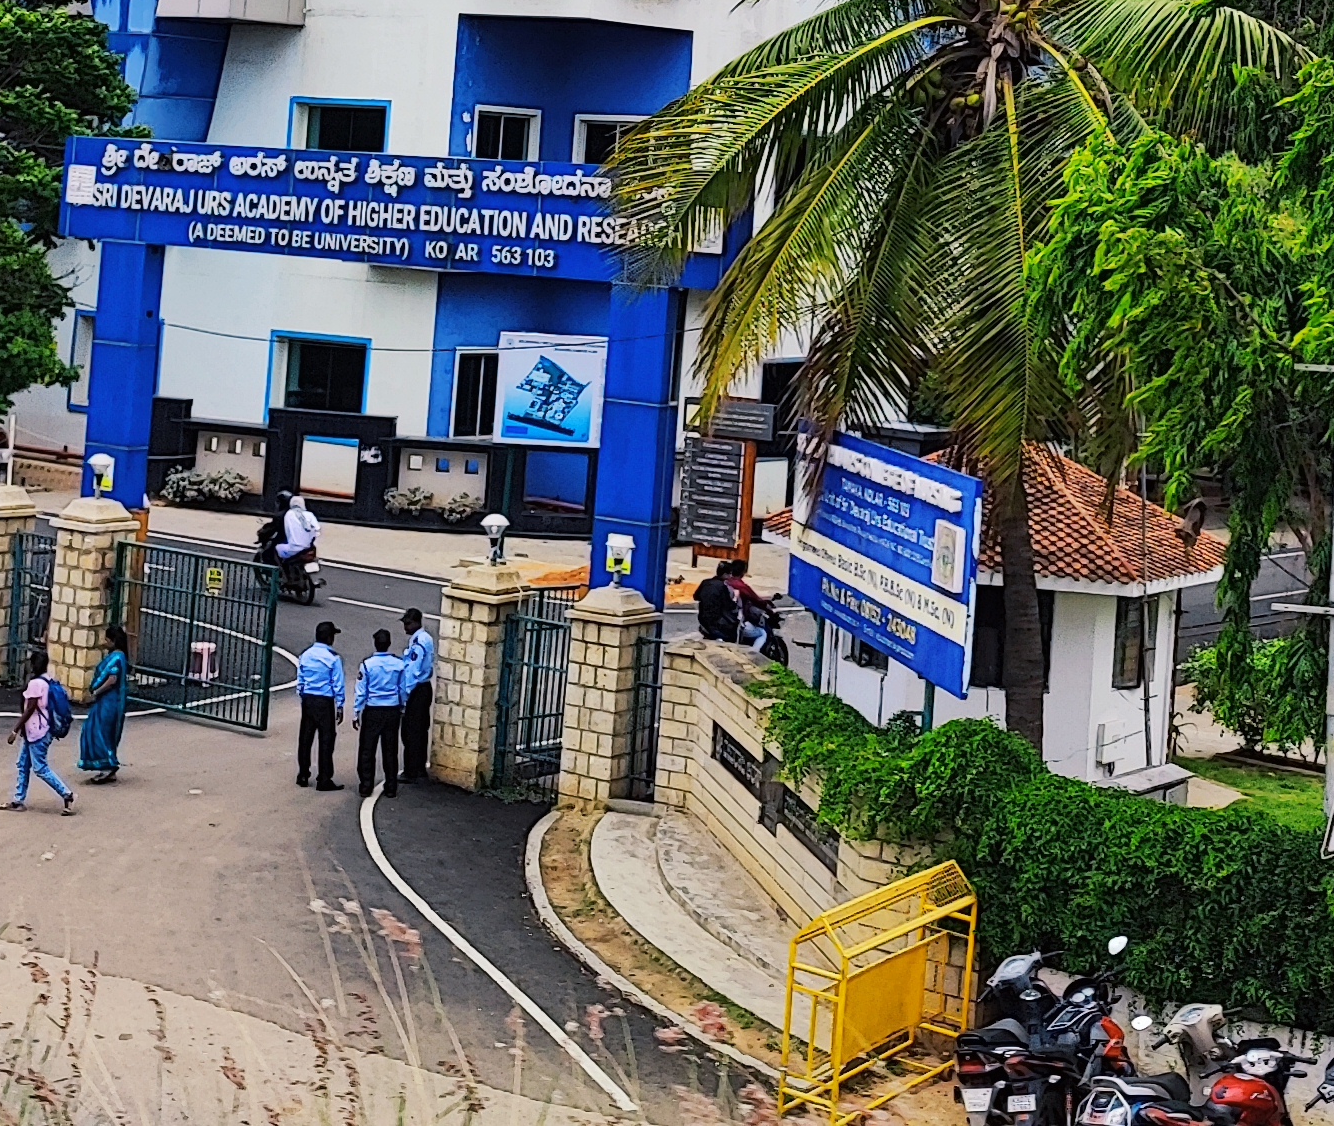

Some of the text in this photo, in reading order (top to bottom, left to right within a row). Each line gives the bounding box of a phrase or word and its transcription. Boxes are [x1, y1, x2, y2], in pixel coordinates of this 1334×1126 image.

[101, 143, 129, 176] ಶ್ರೀ
[293, 155, 358, 194] ಉನ್ನತ
[423, 162, 474, 199] ಮತ್ತು
[93, 184, 118, 208] SRI
[120, 185, 195, 215] DEVARAJ
[197, 191, 232, 217] URS
[233, 194, 319, 222] ACADEMY
[320, 198, 345, 224] OF
[347, 200, 416, 231] HIGHER
[419, 205, 528, 236] EDUCATION
[529, 211, 573, 242] AND
[188, 221, 204, 243] (A
[206, 223, 266, 245] DEEMED
[269, 226, 290, 247] TO
[291, 229, 312, 248] BE
[314, 232, 410, 261] UNIVERSITY)
[491, 244, 521, 265] 563
[525, 247, 555, 268] 103
